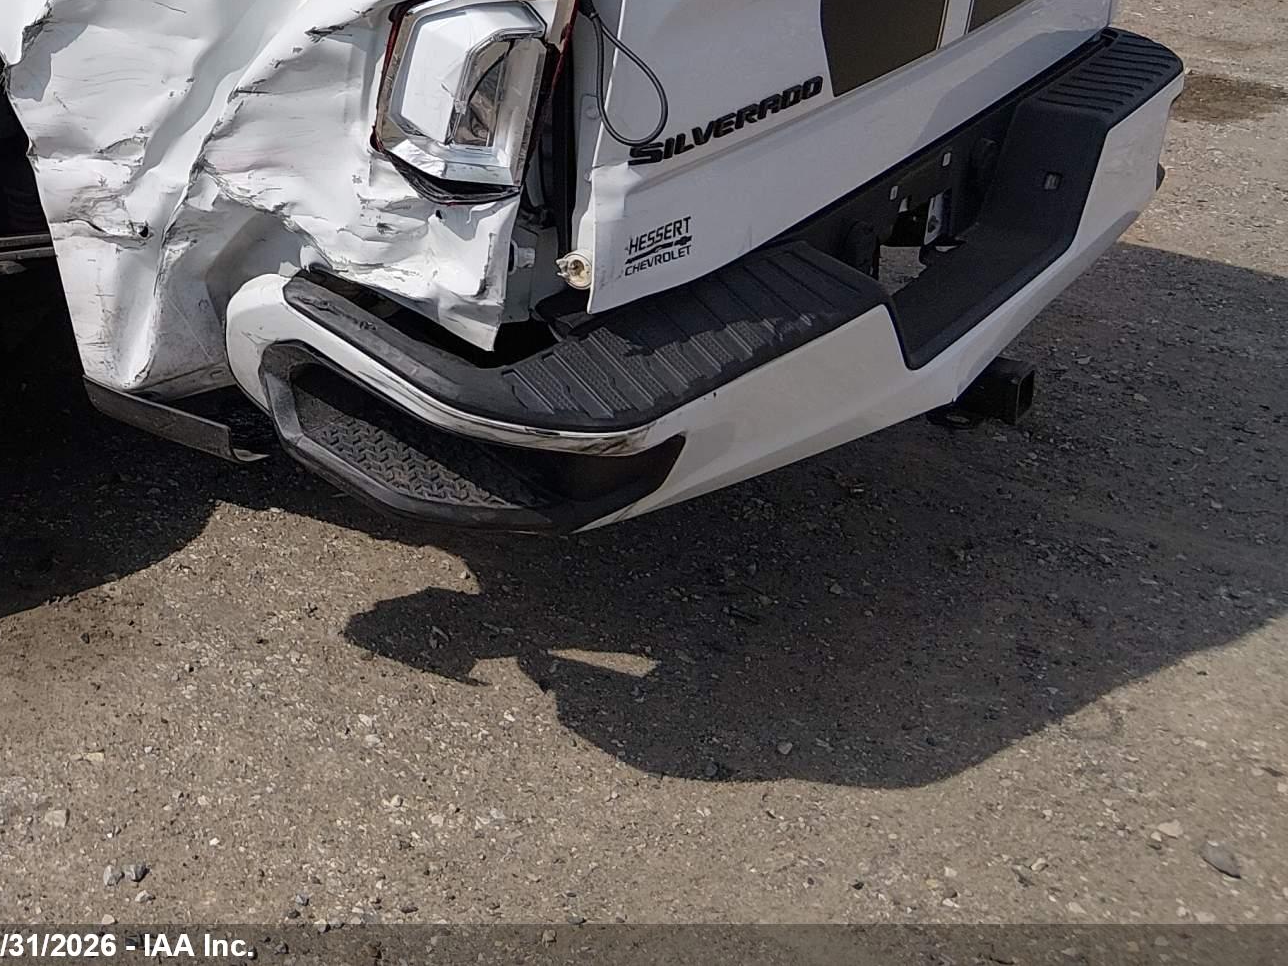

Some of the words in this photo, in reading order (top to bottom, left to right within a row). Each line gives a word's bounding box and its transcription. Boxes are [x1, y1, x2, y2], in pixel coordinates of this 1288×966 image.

[627, 75, 824, 166] SILVERADO
[628, 215, 692, 256] HESSERT
[624, 244, 692, 277] CHEVROLET
